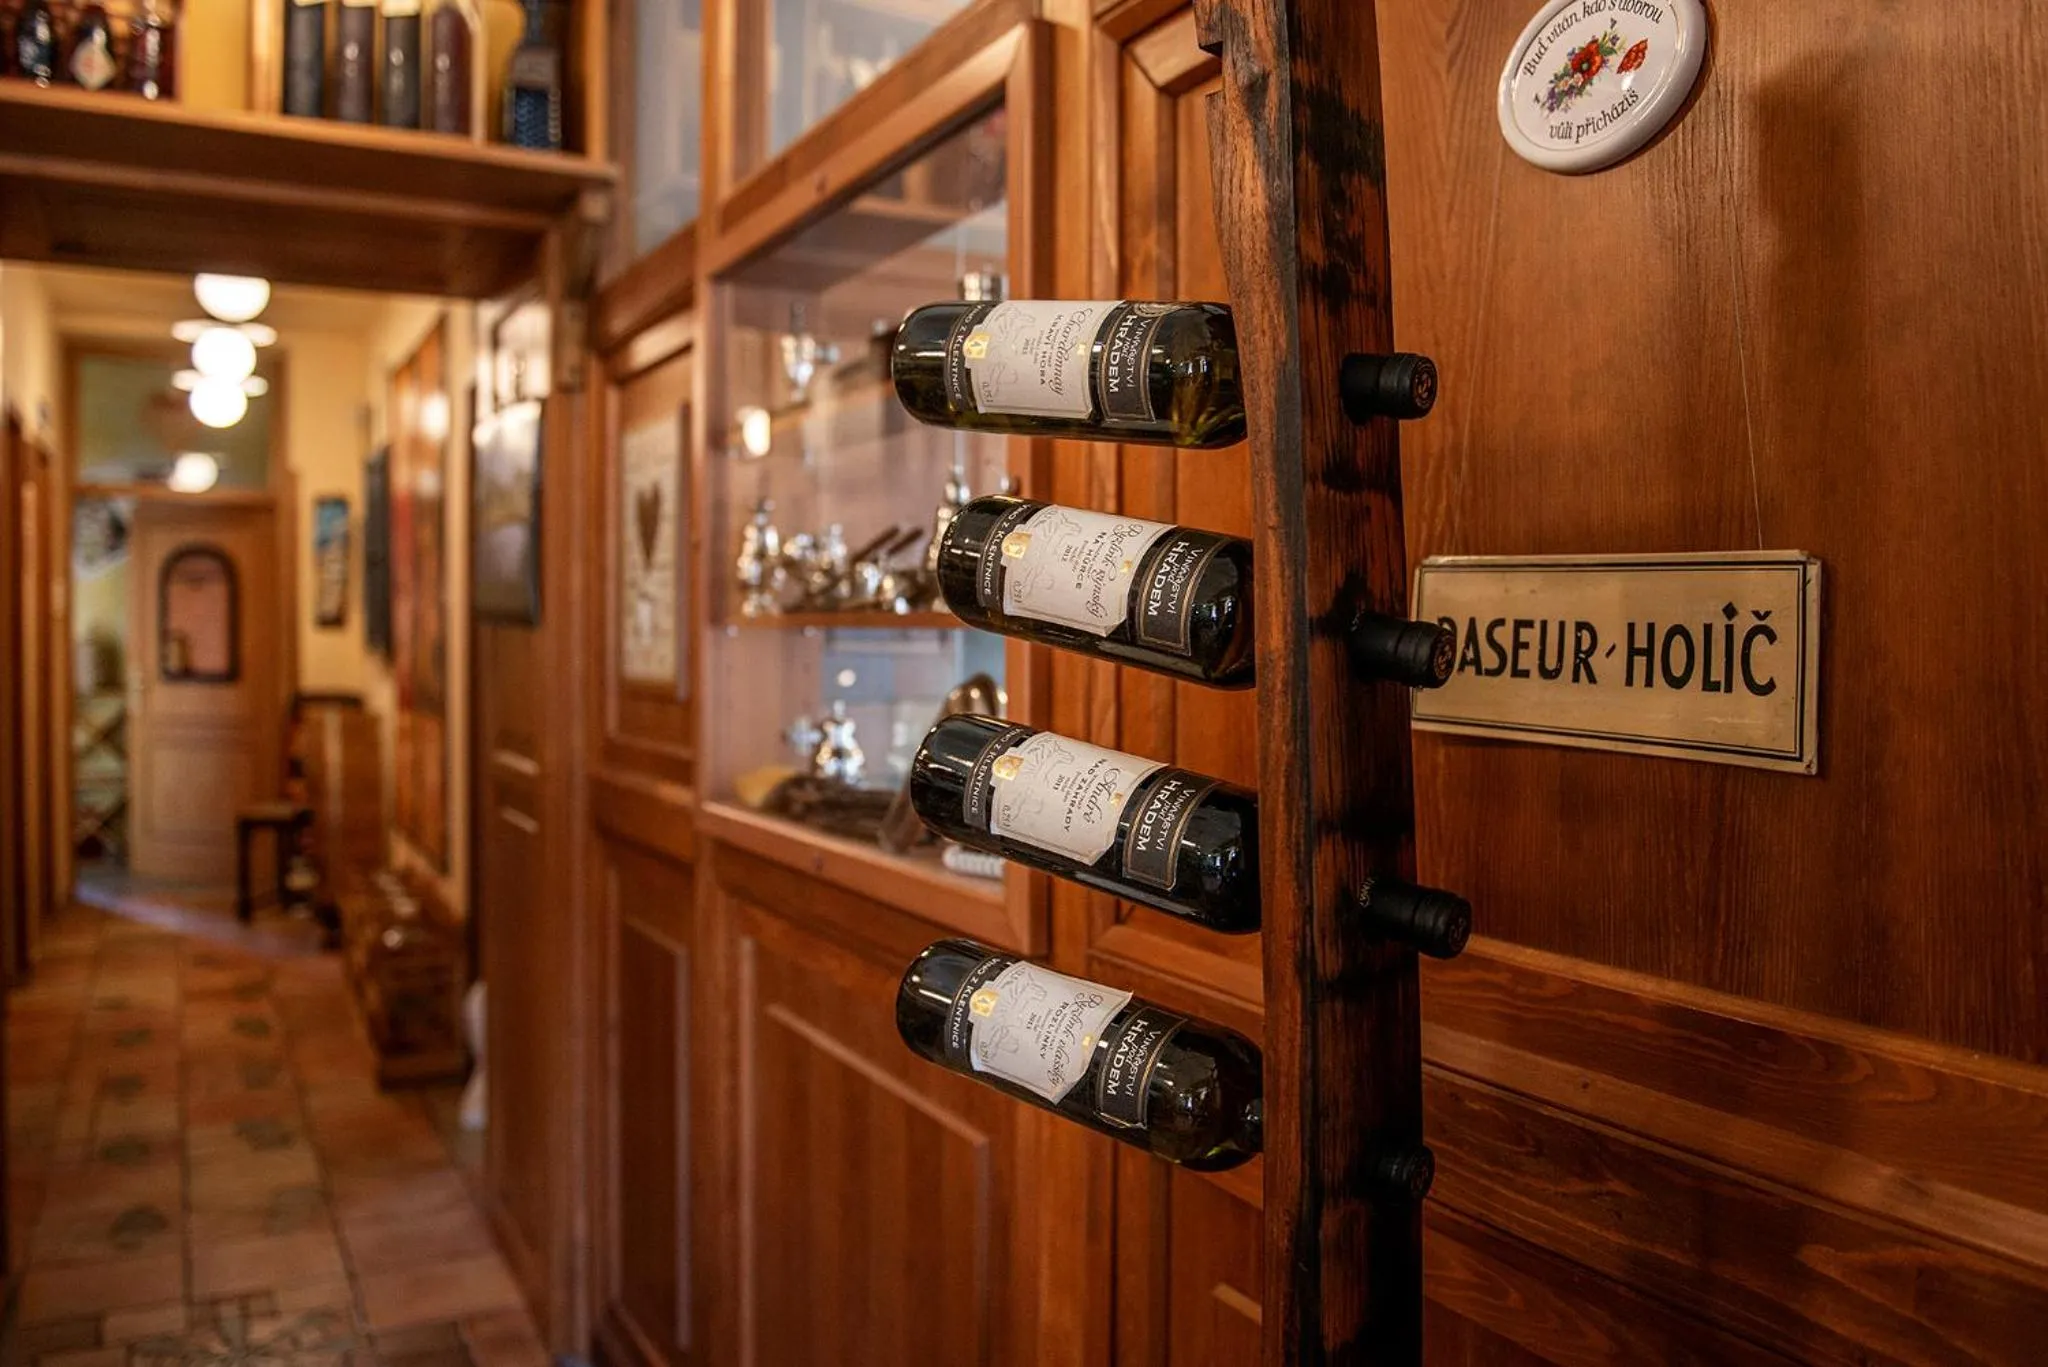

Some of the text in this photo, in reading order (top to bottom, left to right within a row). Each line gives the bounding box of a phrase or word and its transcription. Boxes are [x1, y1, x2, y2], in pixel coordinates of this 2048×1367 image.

[1575, 87, 1639, 144] přicházíš
[952, 335, 964, 400] KLENTNICE
[1048, 307, 1093, 396] Chardonnay
[1108, 314, 1138, 393] HRADEM
[984, 530, 1005, 595] KLENTNICE
[1147, 541, 1190, 616] HRADEM
[971, 751, 997, 814] KLENTNICE
[1087, 758, 1108, 775] NAD
[1064, 777, 1088, 832] ZAHRADY
[1136, 780, 1183, 851] HRADEM
[952, 985, 974, 1049] KLENTNICE
[1107, 1019, 1149, 1095] HRADEM
